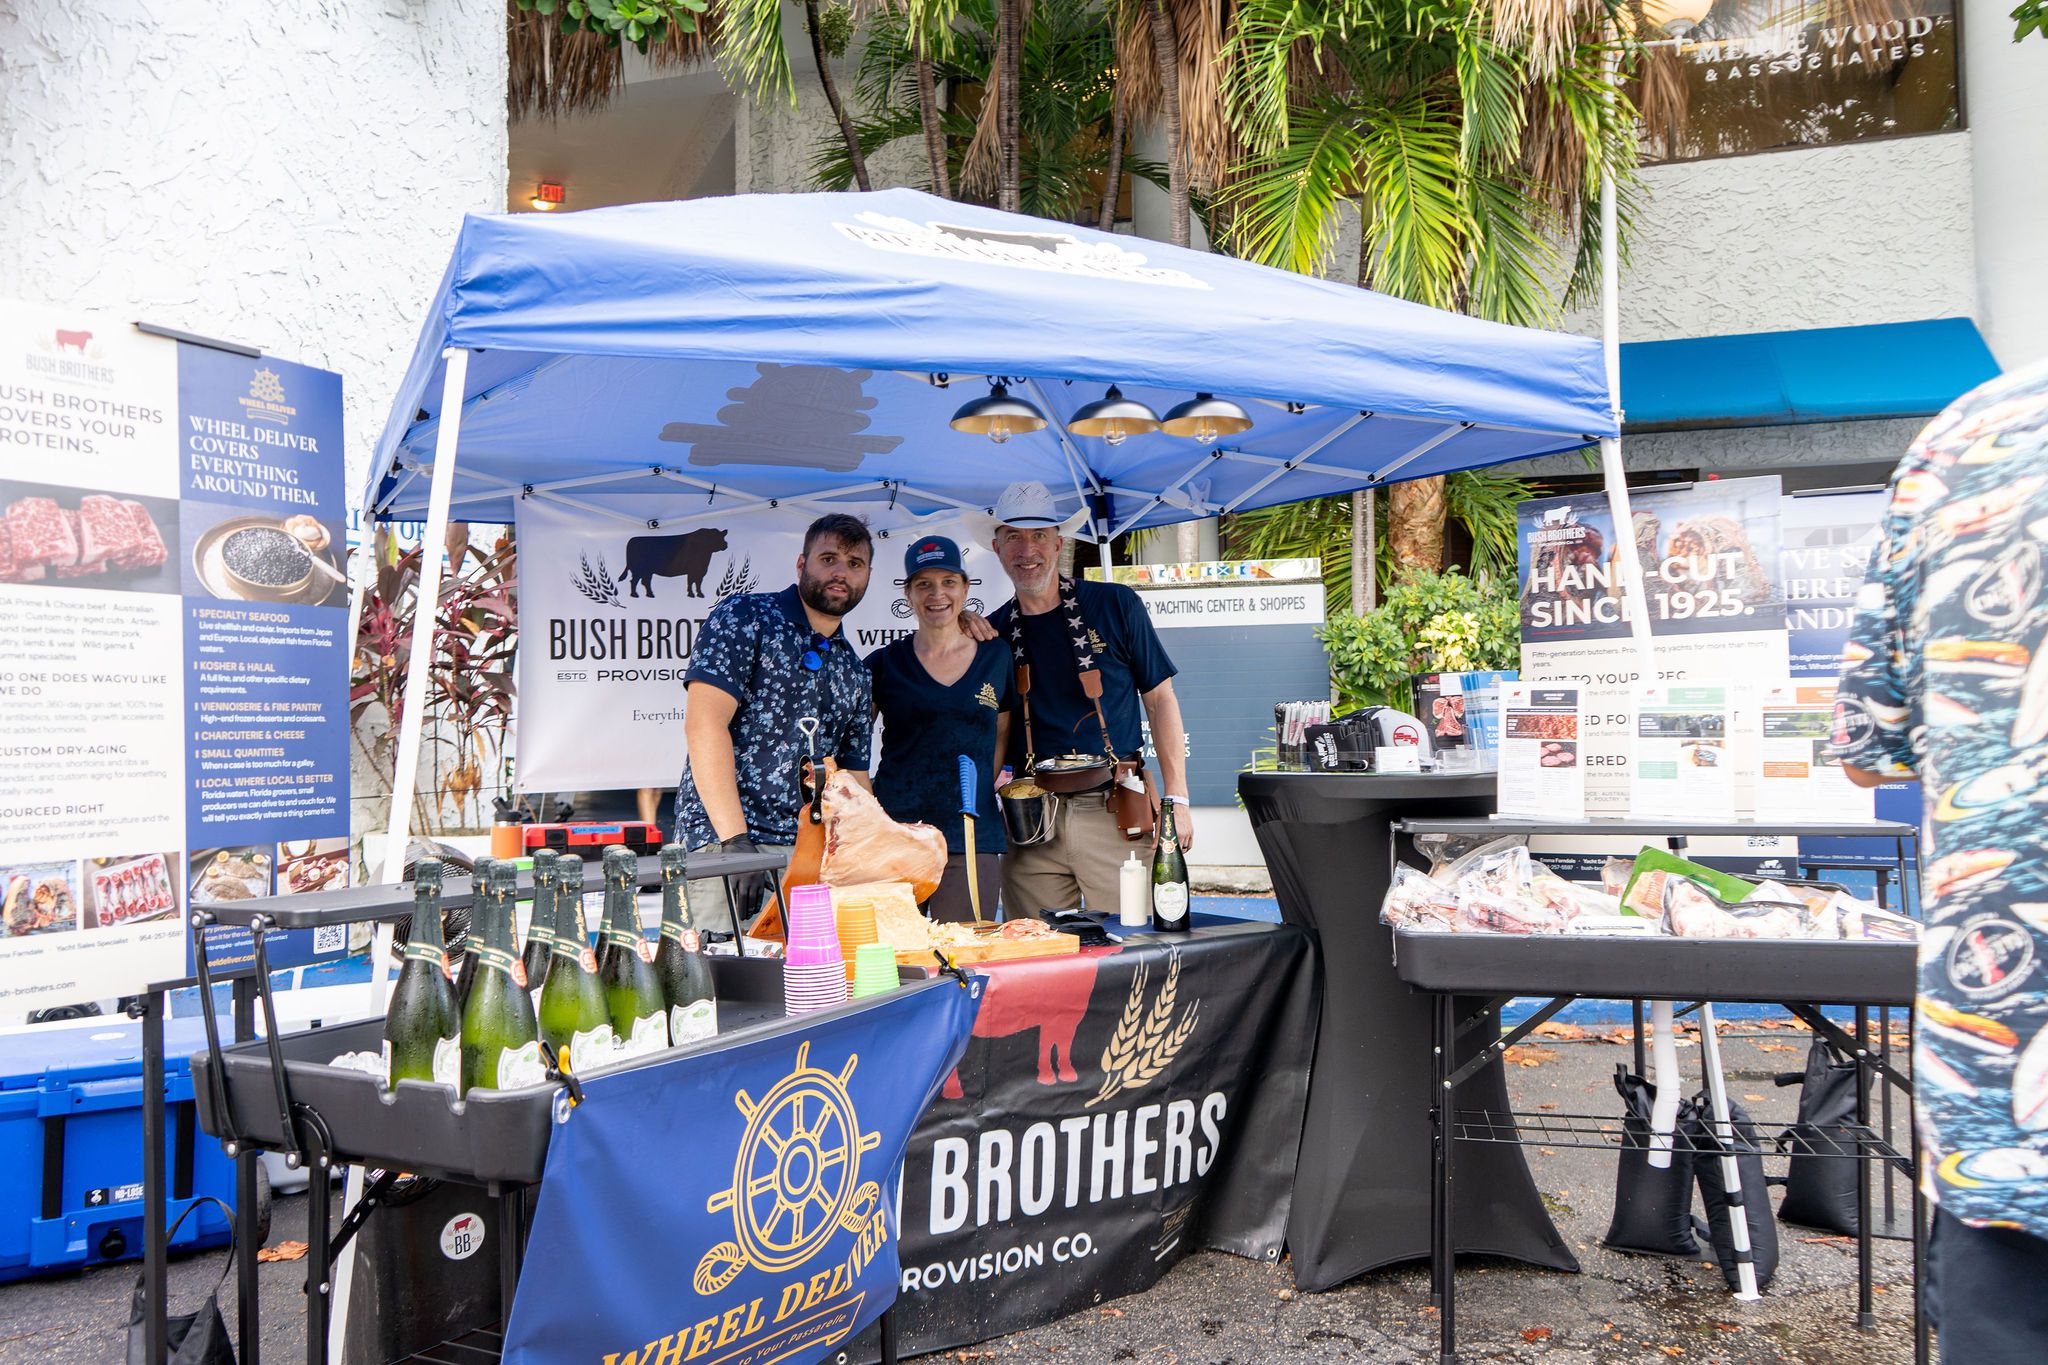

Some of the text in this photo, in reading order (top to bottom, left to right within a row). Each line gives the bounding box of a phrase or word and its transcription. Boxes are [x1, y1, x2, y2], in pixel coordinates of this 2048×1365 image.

[1820, 16, 1934, 48] WOOD
[1705, 43, 1926, 82] & ASSOCIATES
[26, 351, 56, 372] BUSH
[59, 360, 114, 384] BROTHERS
[53, 392, 162, 423] BROTHERS
[0, 406, 135, 439] OVERS YOUR
[190, 415, 250, 440] WHEEL
[254, 427, 319, 453] DELIVER
[0, 428, 99, 454] ROTEINS.
[190, 435, 259, 460] COVERS
[191, 454, 298, 485] EVERYTHING
[190, 473, 319, 506] AROUND THEM.
[1527, 527, 1586, 543] BUSH BROTHERS
[200, 609, 290, 623] SPECIALTY SEAFOOD
[1155, 600, 1203, 614] YACHTING
[1207, 598, 1245, 613] CENTER
[1249, 598, 1256, 611] &
[1260, 596, 1305, 611] SHOPPES
[1654, 588, 1755, 620] 1925.
[550, 618, 627, 661] BUSH
[857, 629, 919, 646] WHE
[19, 673, 167, 684] ONE DOES WAGYU LIKE
[200, 661, 275, 672] KOSHER & HALAL
[21, 686, 41, 696] DO
[201, 702, 322, 711] VIENNOISERIE & FINE PANTRY
[633, 708, 685, 724] Everythi
[201, 730, 304, 740] CHARCUTERIE & CHEESE
[57, 745, 127, 755] DRY-AGING
[202, 748, 284, 758] SMALL QUANTITIES
[202, 774, 333, 788] LOCAL WHERE LOCAL IS BETTER
[66, 804, 104, 814] RIGHT
[929, 1091, 1227, 1236] BROTHERS
[1161, 1203, 1193, 1232] 1925
[455, 1233, 471, 1255] BB
[773, 1209, 889, 1324] DELIVER
[901, 1232, 1099, 1293] ROVISION CO.
[758, 1339, 786, 1360] Your
[788, 1313, 847, 1343] Passarelle
